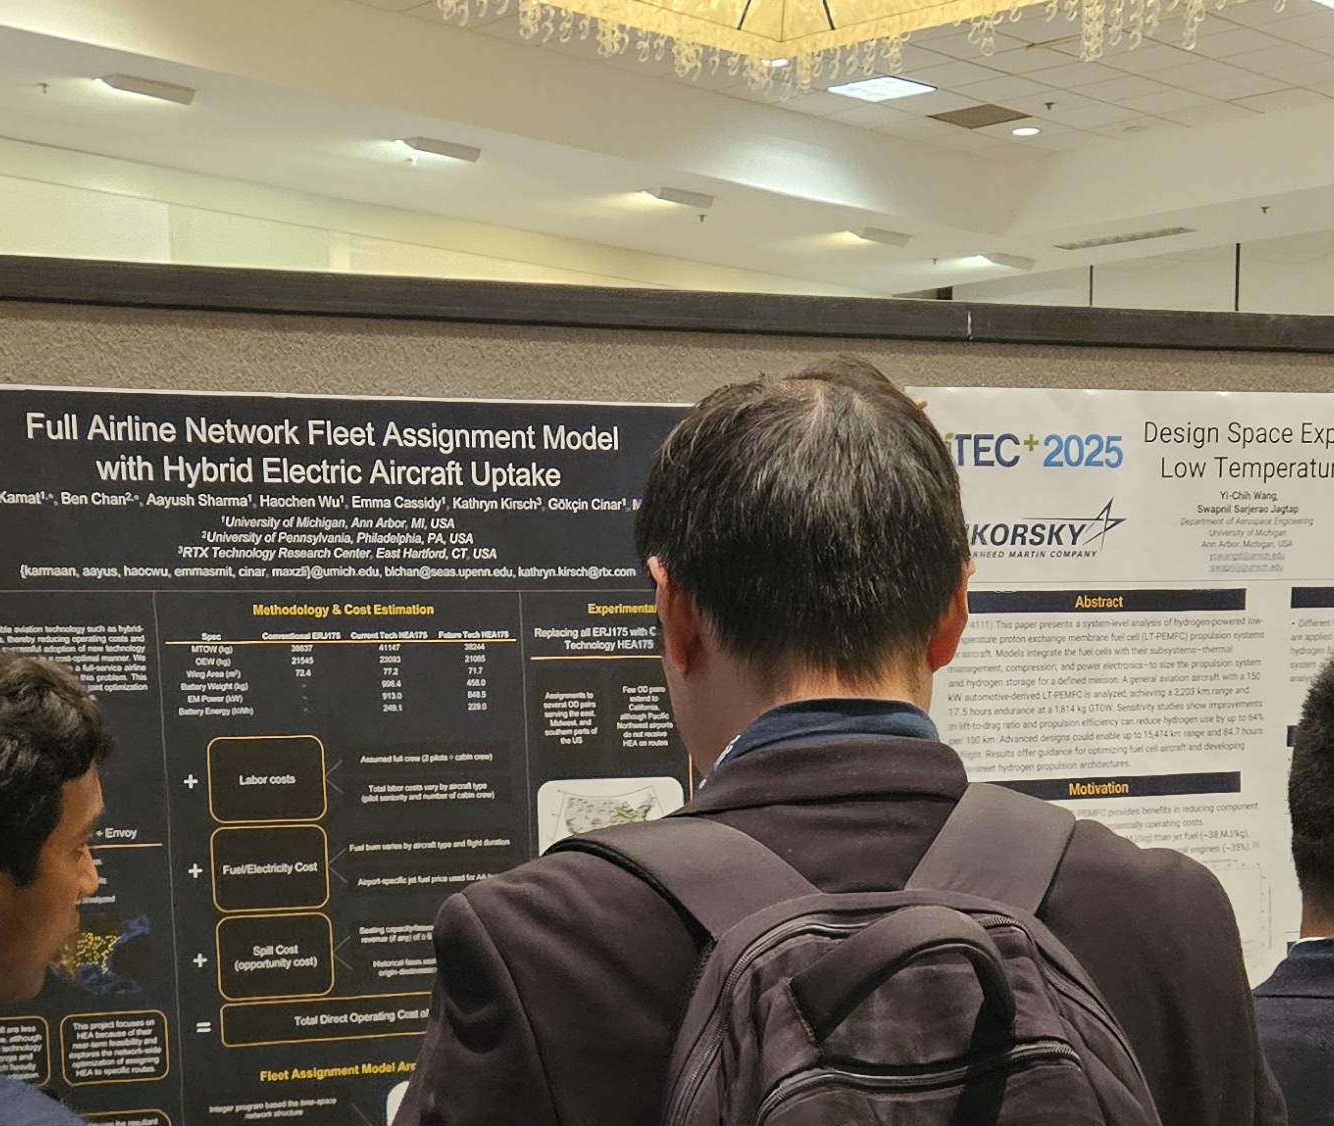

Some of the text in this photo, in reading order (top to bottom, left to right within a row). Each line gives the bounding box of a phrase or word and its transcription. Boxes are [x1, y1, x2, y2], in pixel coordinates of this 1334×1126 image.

[26, 412, 618, 452] Full Airline Network Fleet Assignment Model
[1144, 421, 1218, 448] Design
[1227, 421, 1292, 446] Space
[1043, 434, 1124, 469] 2025
[95, 455, 560, 492] with Hybrid Electric Aircraft Uptake
[1161, 456, 1206, 478] Low
[60, 491, 88, 505] Ben
[146, 492, 194, 508] Aayush
[259, 494, 315, 507] Haochen
[351, 495, 391, 508] Emma
[452, 496, 497, 512] Kathryn
[547, 497, 588, 513] Gökçin
[1219, 490, 1278, 502] Yi-Chih Wang,
[1197, 504, 1298, 515] Swapnil Sarjerao Jagtap
[282, 516, 294, 527] of
[296, 516, 347, 529] Michigan,
[350, 516, 373, 527] Ann
[375, 516, 407, 528] Arbor,
[410, 517, 427, 529] MI,
[430, 517, 454, 528] USA
[264, 531, 276, 542] of
[277, 531, 353, 545] Pennsylvania,
[356, 531, 424, 545] Philadelphia,
[427, 532, 446, 545] PA,
[449, 532, 473, 544] USA
[966, 523, 1087, 546] KORSKY
[211, 546, 276, 560] Technology
[277, 547, 331, 558] Research
[333, 547, 371, 558] Center,
[375, 547, 400, 558] East
[402, 547, 448, 559] Hartford,
[451, 547, 468, 559] CT,
[472, 547, 496, 559] USA
[1074, 594, 1123, 607] Abstract
[252, 603, 434, 617] Methodology & Cost Estimation
[534, 626, 579, 640] Replacing
[581, 627, 591, 638] all
[592, 627, 629, 637] ERJ175
[630, 627, 648, 637] with
[563, 638, 654, 651] Technology HEA175
[239, 774, 296, 785] Labor costs
[1068, 781, 1128, 795] Motivation
[104, 827, 137, 839] Envoy
[222, 861, 317, 874] Fuel/Electricity Cost
[252, 944, 298, 957] Spill Cost
[234, 955, 317, 971] (opportunity cost)
[293, 1015, 318, 1026] Total
[319, 1013, 348, 1024] Direct
[349, 1010, 395, 1023] Operating
[396, 1009, 419, 1019] Cost
[259, 1069, 289, 1081] Fleet
[291, 1064, 359, 1080] Assignment
[361, 1061, 395, 1073] Model
